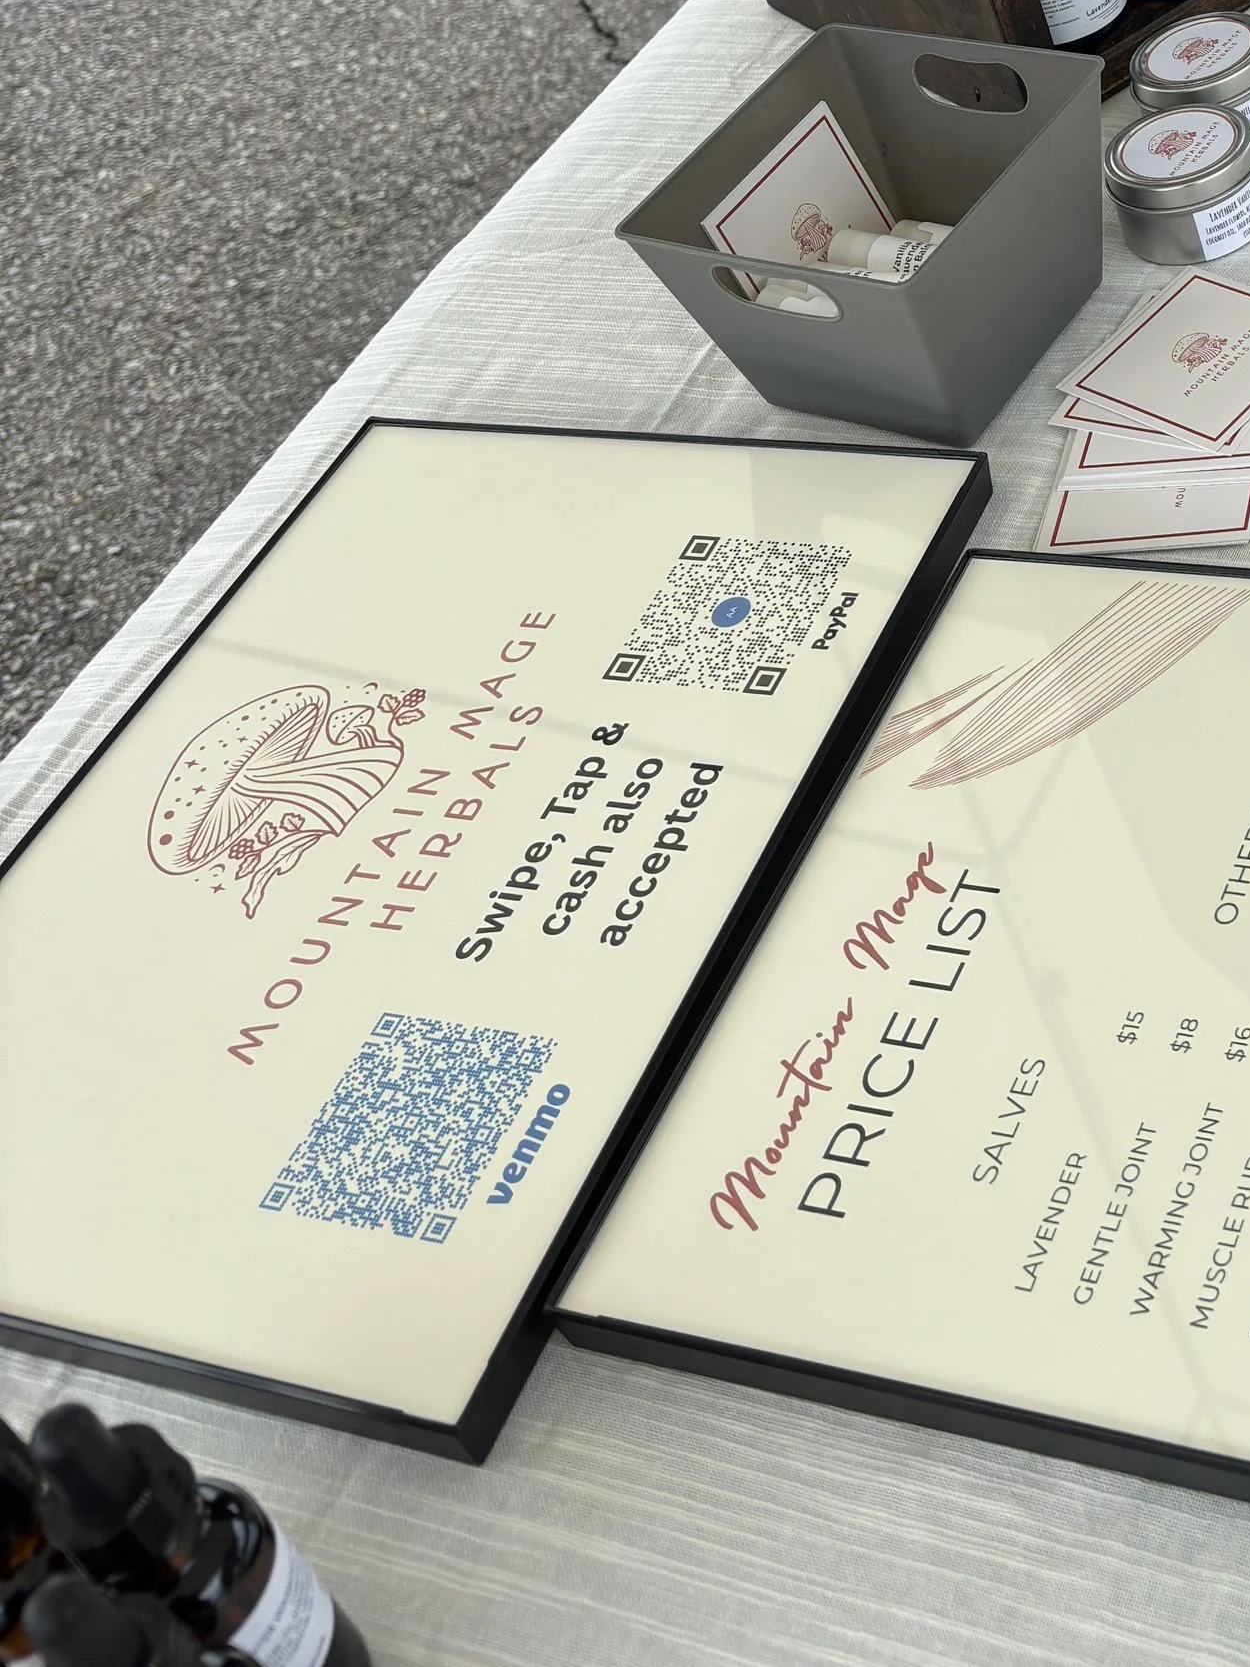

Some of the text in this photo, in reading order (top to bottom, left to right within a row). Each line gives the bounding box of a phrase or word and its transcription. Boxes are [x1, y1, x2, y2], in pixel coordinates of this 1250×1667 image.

[1185, 30, 1242, 80] MOUNTAIN MAGE
[1206, 42, 1237, 69] HERBALS
[1169, 121, 1220, 176] MOUNTAIN MAGE
[1191, 133, 1218, 163] HERBALS
[893, 241, 912, 272] Vanilla
[1206, 231, 1227, 245] COCONUT
[1209, 202, 1237, 222] LAVENDER
[1184, 353, 1230, 397] MOUNTAIN
[1211, 346, 1250, 382] HERBALS
[811, 592, 859, 650] PayPal
[227, 612, 556, 1065] MOUNTAIN MAGE
[370, 706, 543, 930] HERBALS
[455, 723, 629, 962] Swipe, Tap &
[542, 758, 663, 935] cash also
[600, 762, 724, 946] accepted
[709, 840, 948, 1232] Mountain Mage
[797, 869, 1000, 1218] PRICE LIST
[486, 1084, 570, 1204] venmo
[973, 1059, 1045, 1184] SALVES
[1014, 1011, 1144, 1292] LAVENDER $15
[1074, 1019, 1198, 1305] GENTLE JOINT $18
[1129, 1181, 1195, 1315] WARMING
[1183, 1102, 1223, 1176] JOINT
[1189, 1217, 1244, 1329] MUSCLE
